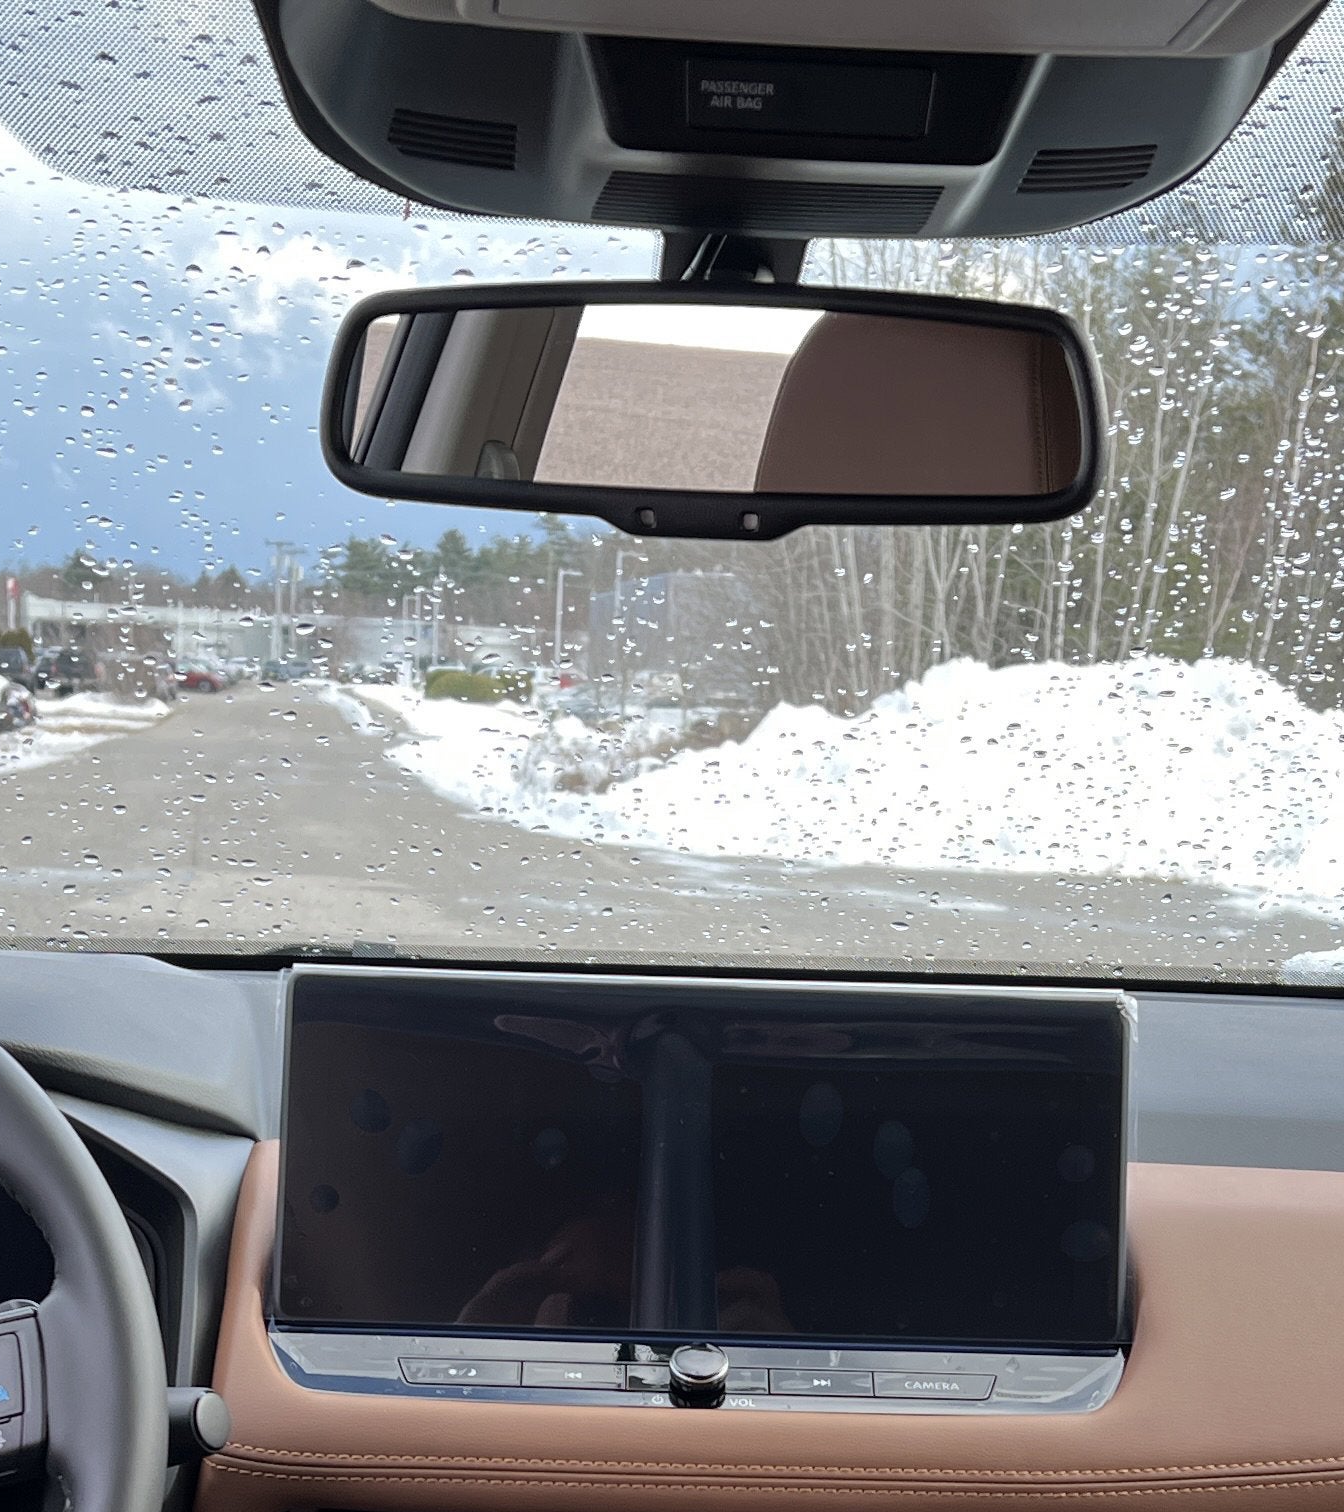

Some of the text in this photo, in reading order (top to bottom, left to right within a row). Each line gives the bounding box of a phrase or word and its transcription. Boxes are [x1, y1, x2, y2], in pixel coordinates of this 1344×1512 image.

[701, 79, 774, 95] PASSENGER
[710, 95, 763, 110] AIR BAG
[904, 1380, 960, 1392] CAMERA
[729, 1397, 756, 1407] VOL
